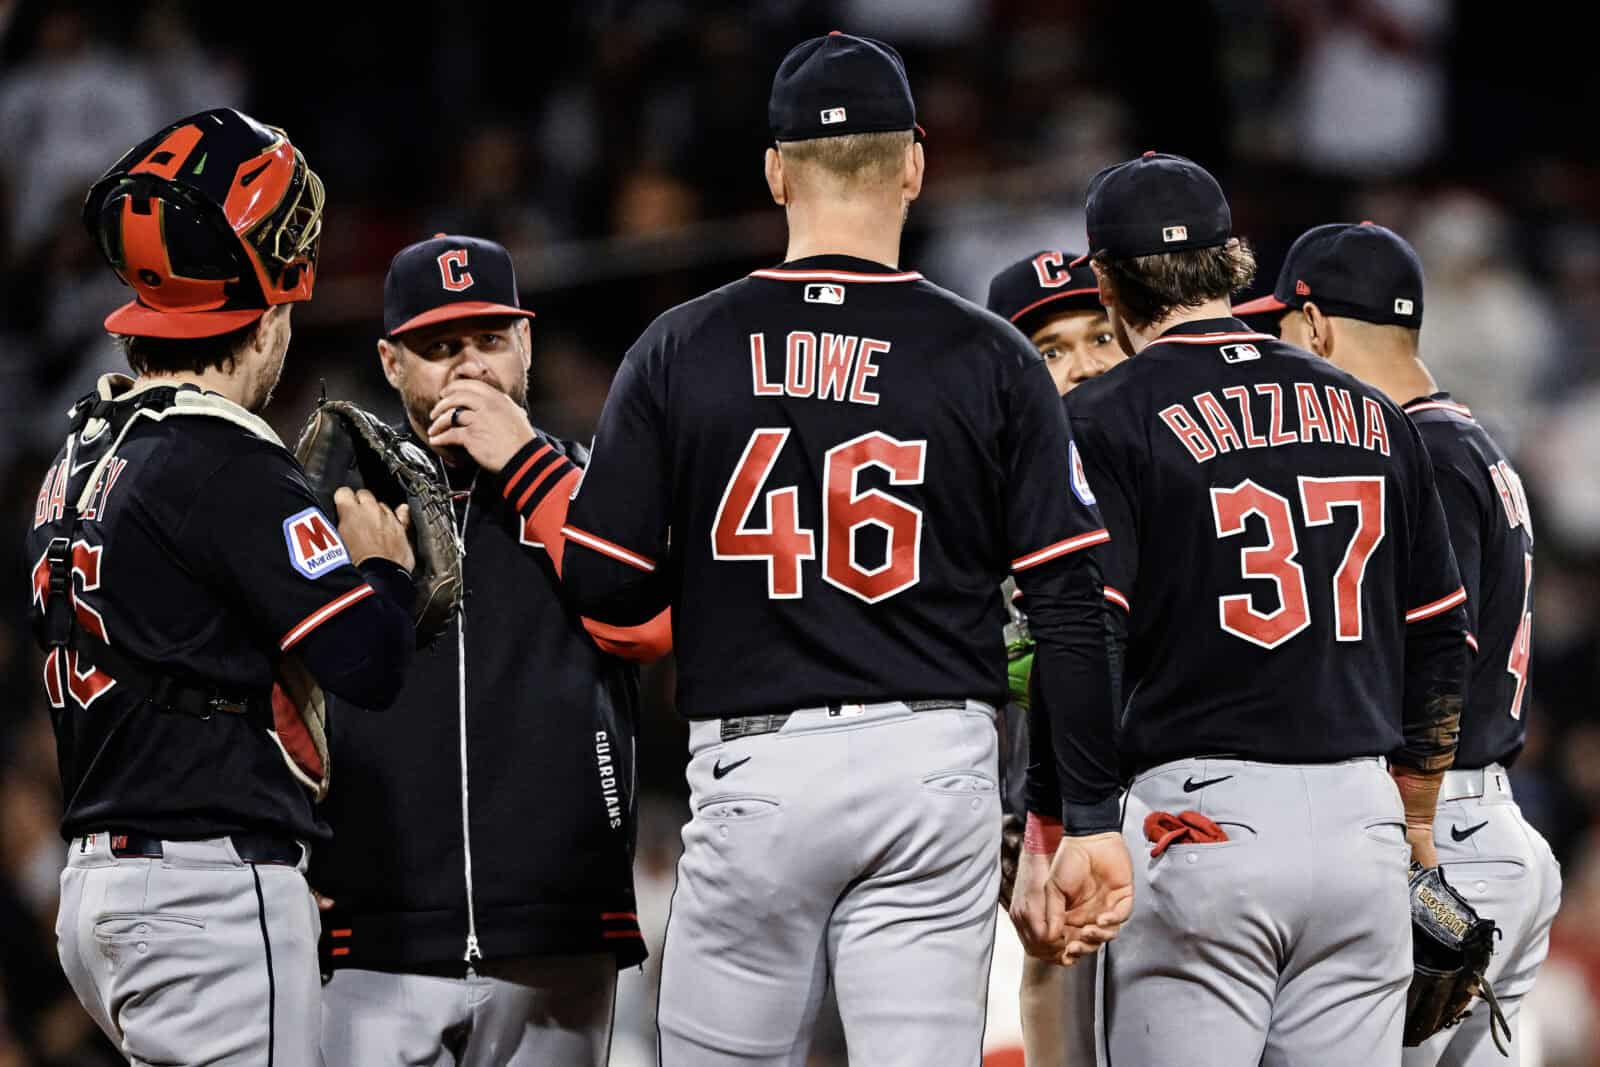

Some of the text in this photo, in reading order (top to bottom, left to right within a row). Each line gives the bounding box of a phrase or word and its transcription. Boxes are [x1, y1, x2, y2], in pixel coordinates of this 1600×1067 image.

[437, 248, 474, 292] C
[1031, 250, 1072, 288] C
[750, 331, 891, 405] LOWE
[1158, 382, 1391, 463] BAZZANA
[294, 516, 338, 561] M
[711, 427, 927, 604] 46
[1209, 475, 1386, 649] 37
[595, 730, 622, 830] GUARDIANS
